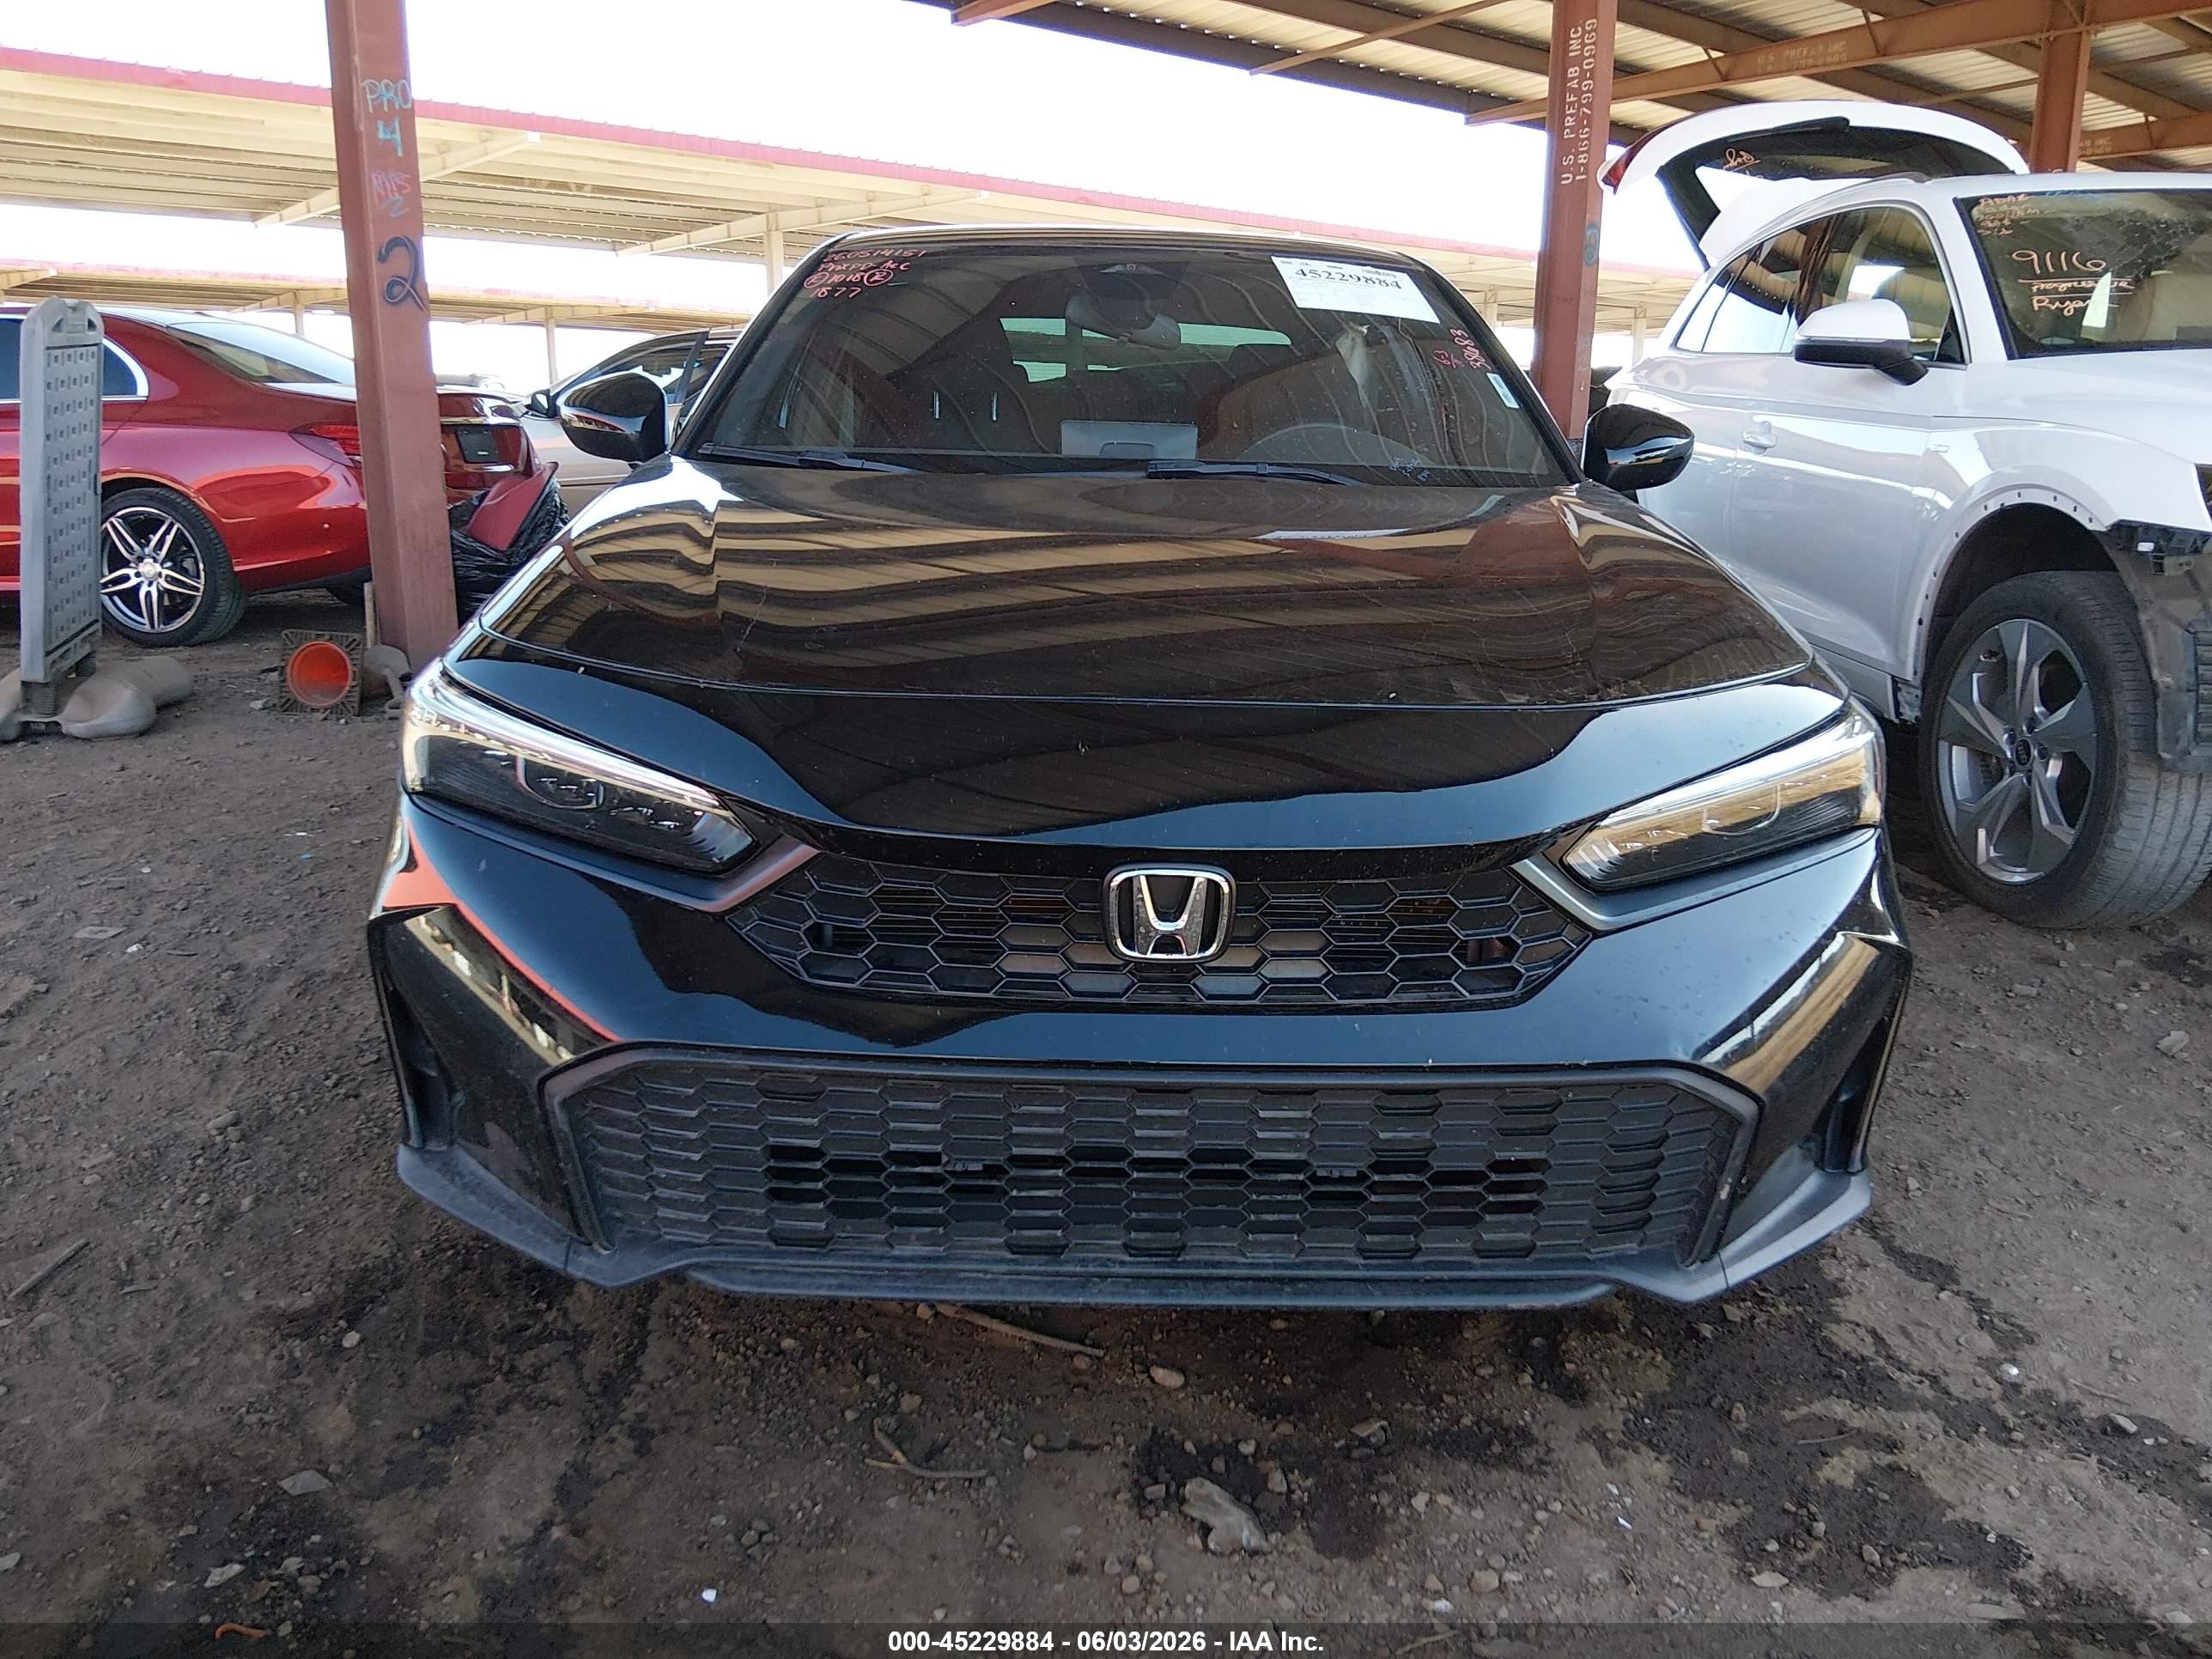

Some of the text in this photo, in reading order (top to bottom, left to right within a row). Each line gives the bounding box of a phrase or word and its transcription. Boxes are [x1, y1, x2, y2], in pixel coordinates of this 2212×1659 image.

[362, 79, 412, 113] PRO
[1564, 66, 1580, 138] PREFAB
[1576, 18, 1597, 179] 1-866-799-0969
[377, 117, 404, 157] 4
[378, 235, 428, 311] 2
[1294, 268, 1401, 289] 45229884
[2012, 250, 2106, 275] 9116
